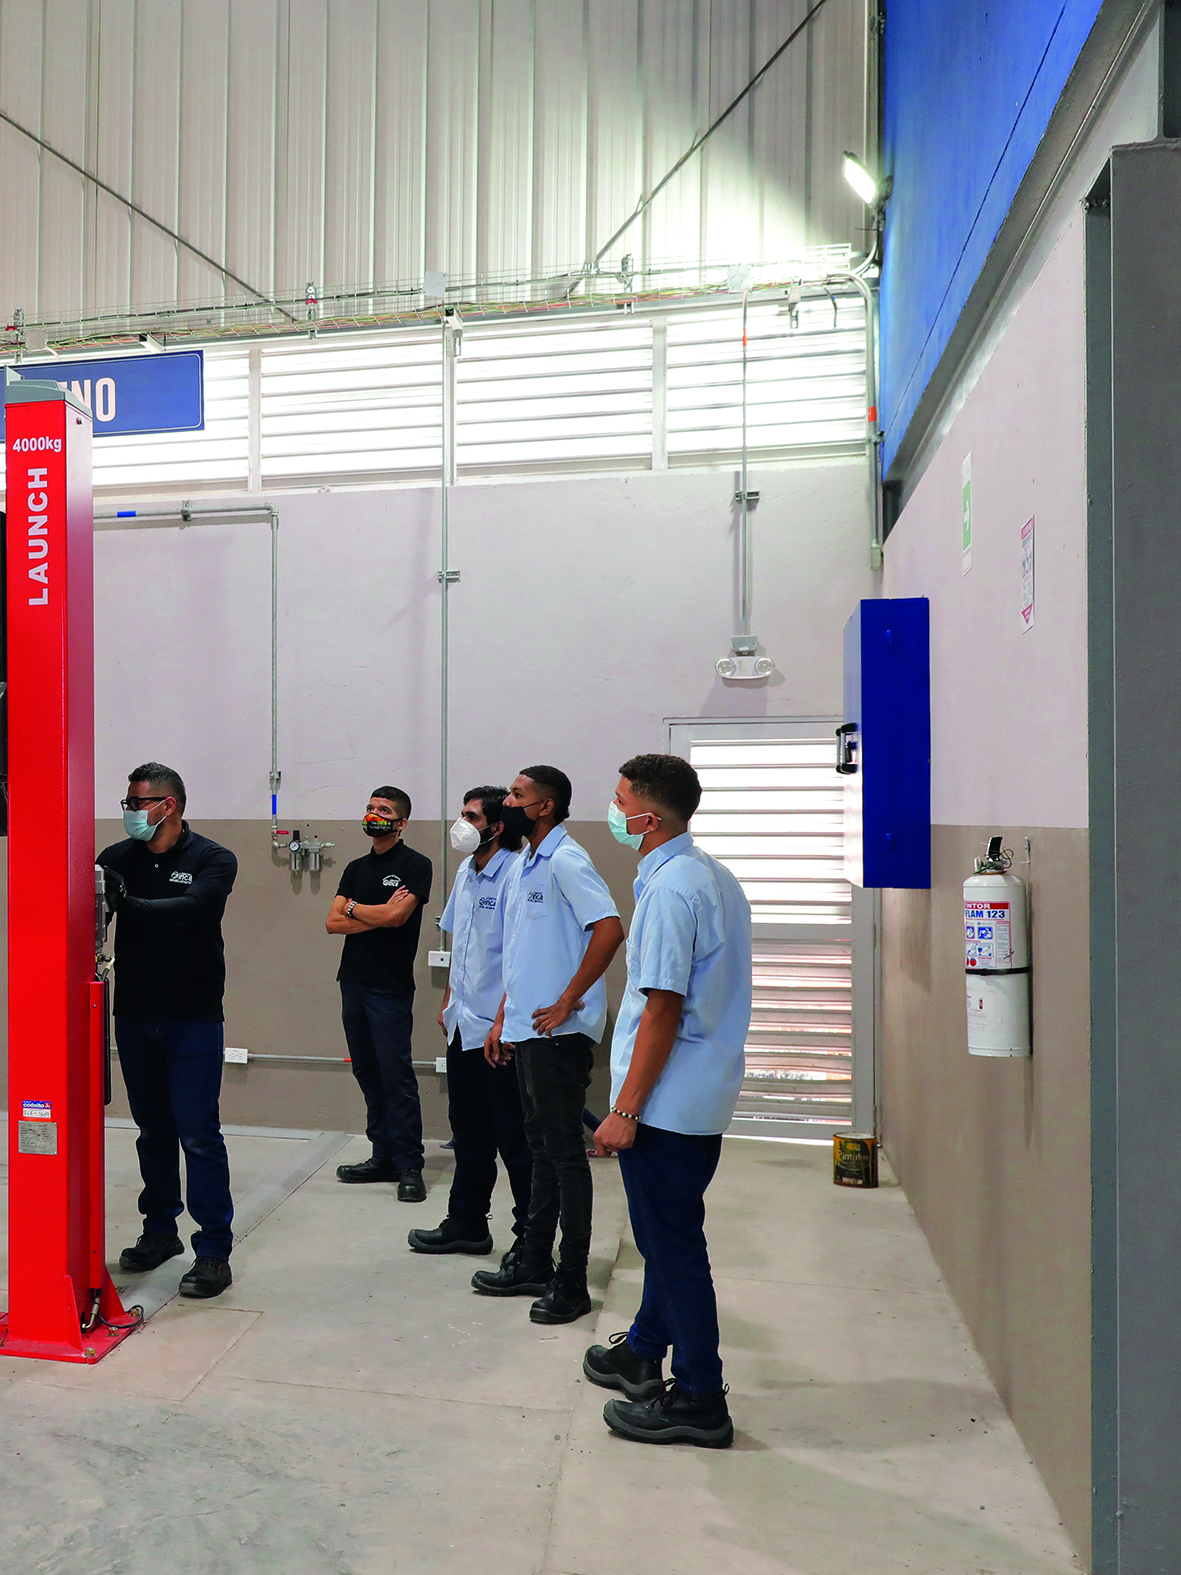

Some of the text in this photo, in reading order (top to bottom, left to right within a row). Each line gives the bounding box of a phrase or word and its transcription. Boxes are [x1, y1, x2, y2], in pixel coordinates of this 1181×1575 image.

[60, 377, 117, 423] NO
[12, 435, 62, 453] 4000kg
[26, 467, 49, 606] LAUNCH
[986, 910, 1005, 918] 123
